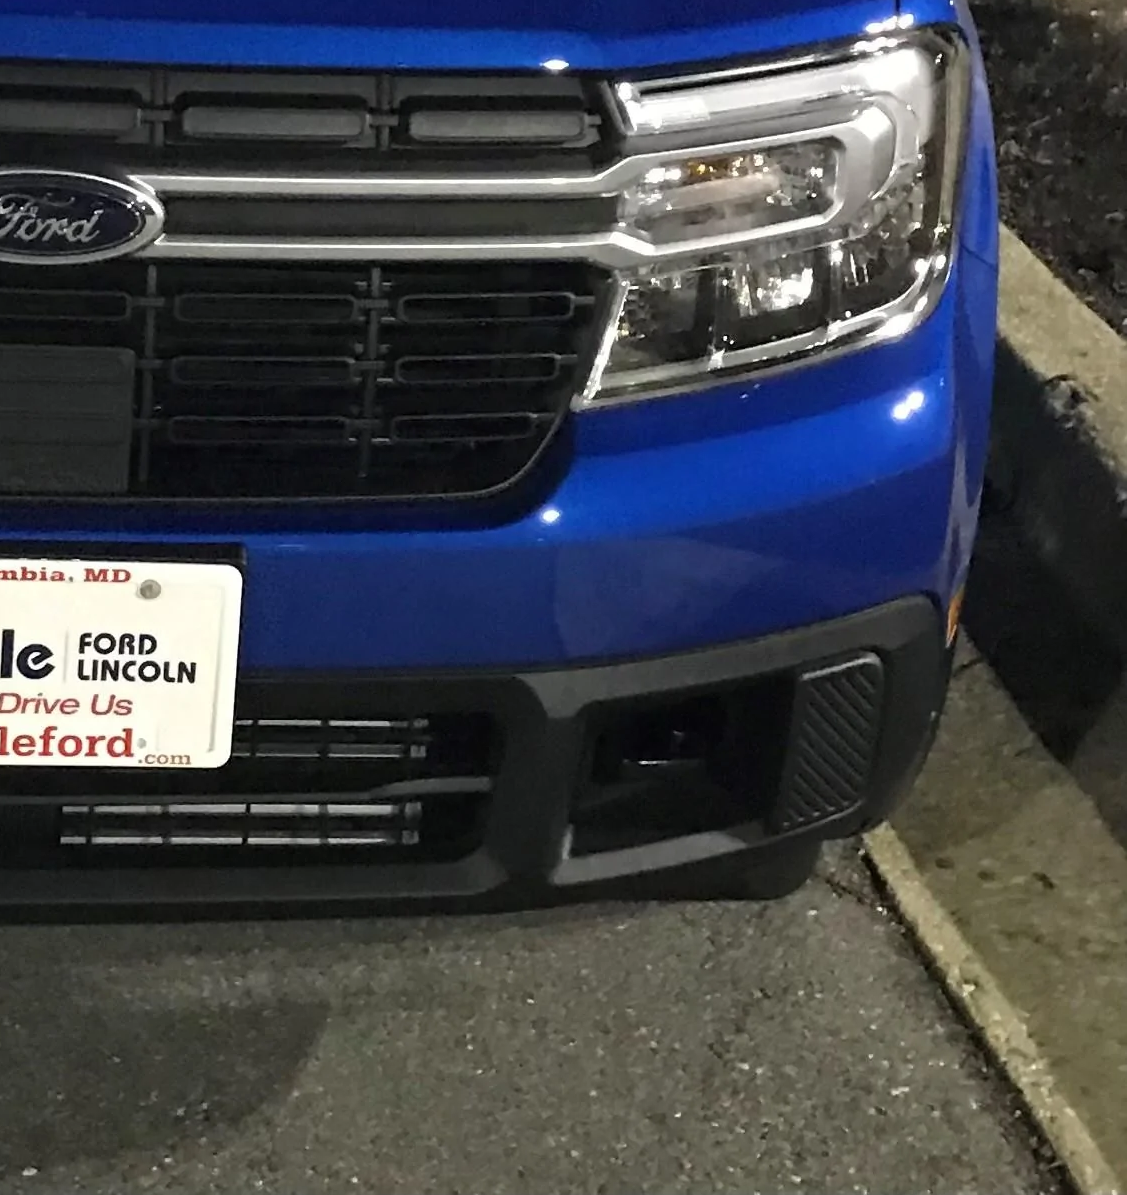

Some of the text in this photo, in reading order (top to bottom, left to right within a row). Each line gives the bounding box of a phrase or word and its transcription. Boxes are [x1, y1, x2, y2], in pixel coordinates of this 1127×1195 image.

[83, 568, 132, 583] MD
[78, 632, 158, 656] FORD
[77, 659, 197, 684] LINCOLN
[90, 694, 134, 716] Us
